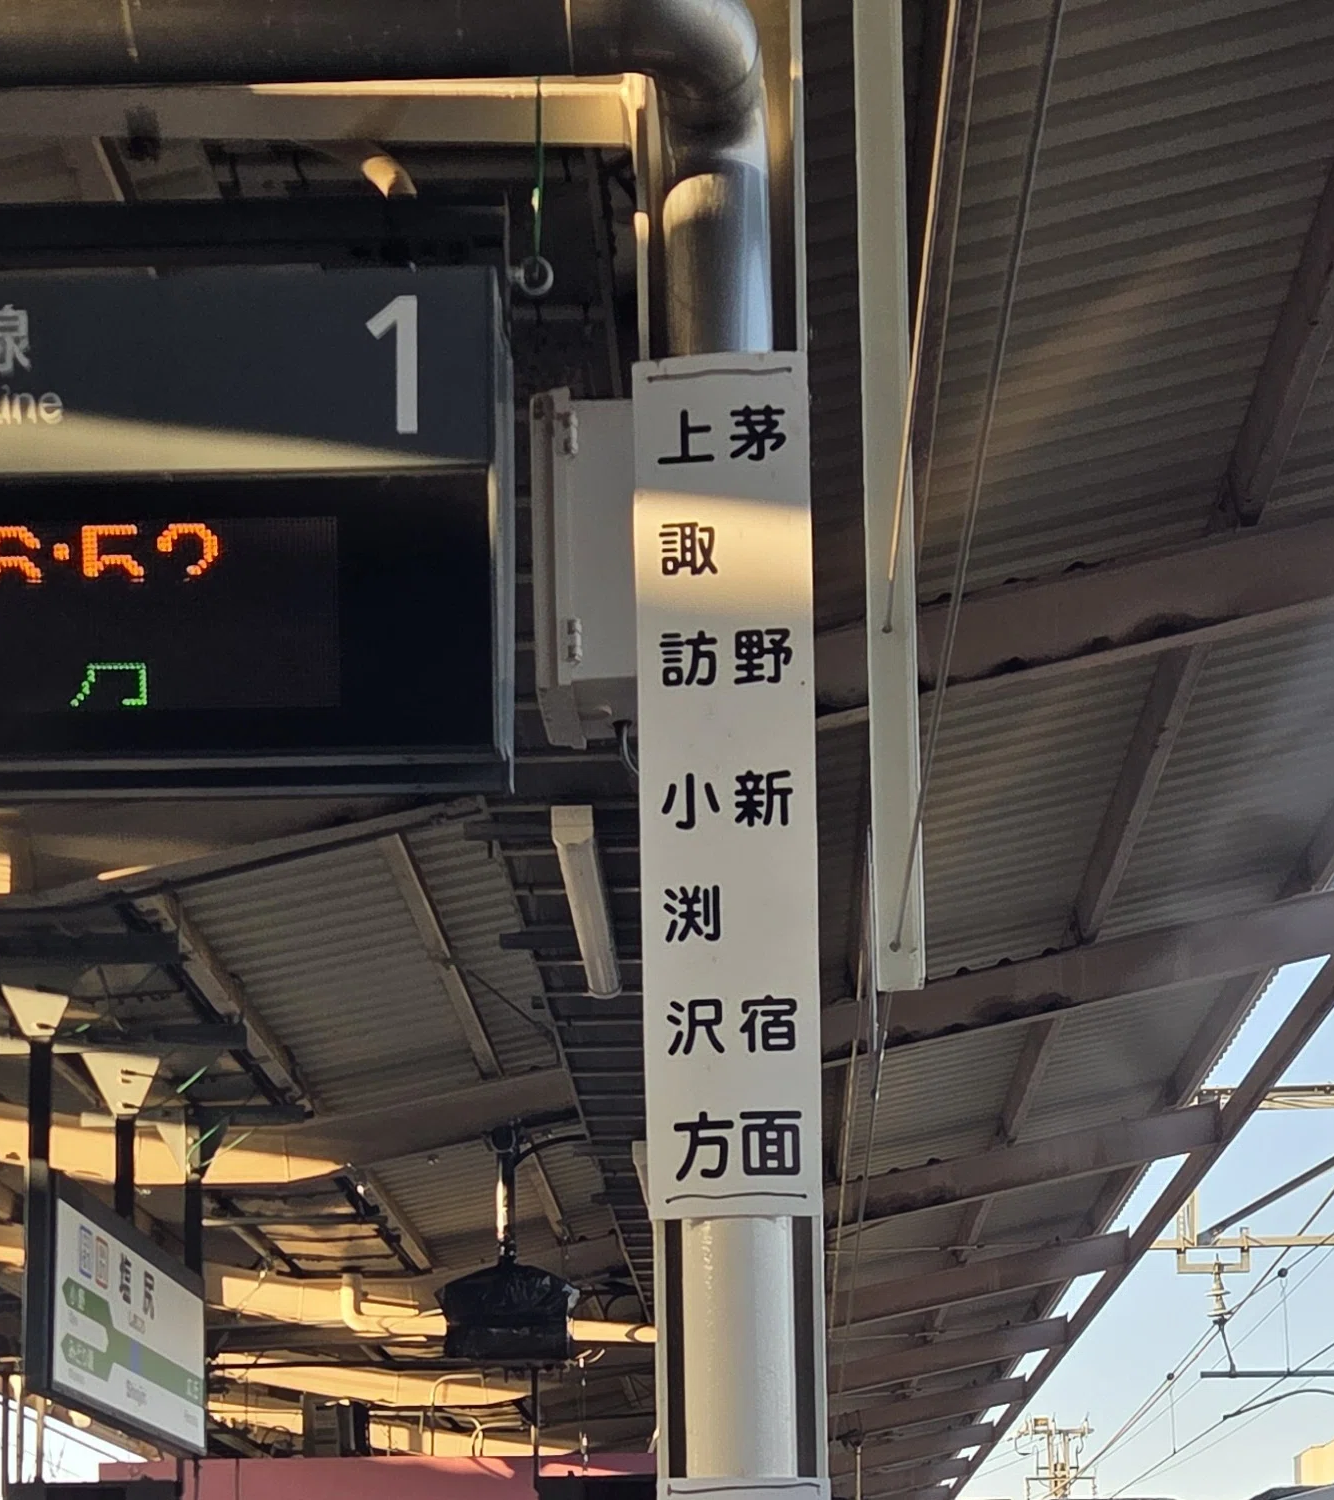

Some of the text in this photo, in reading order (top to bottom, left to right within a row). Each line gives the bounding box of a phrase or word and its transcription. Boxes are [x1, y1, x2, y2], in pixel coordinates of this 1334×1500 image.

[364, 294, 419, 434] 1
[657, 409, 718, 687] 上諏訪
[729, 404, 794, 686] 茅野
[733, 770, 798, 1053] 新宿
[673, 1111, 802, 1182] 方面
